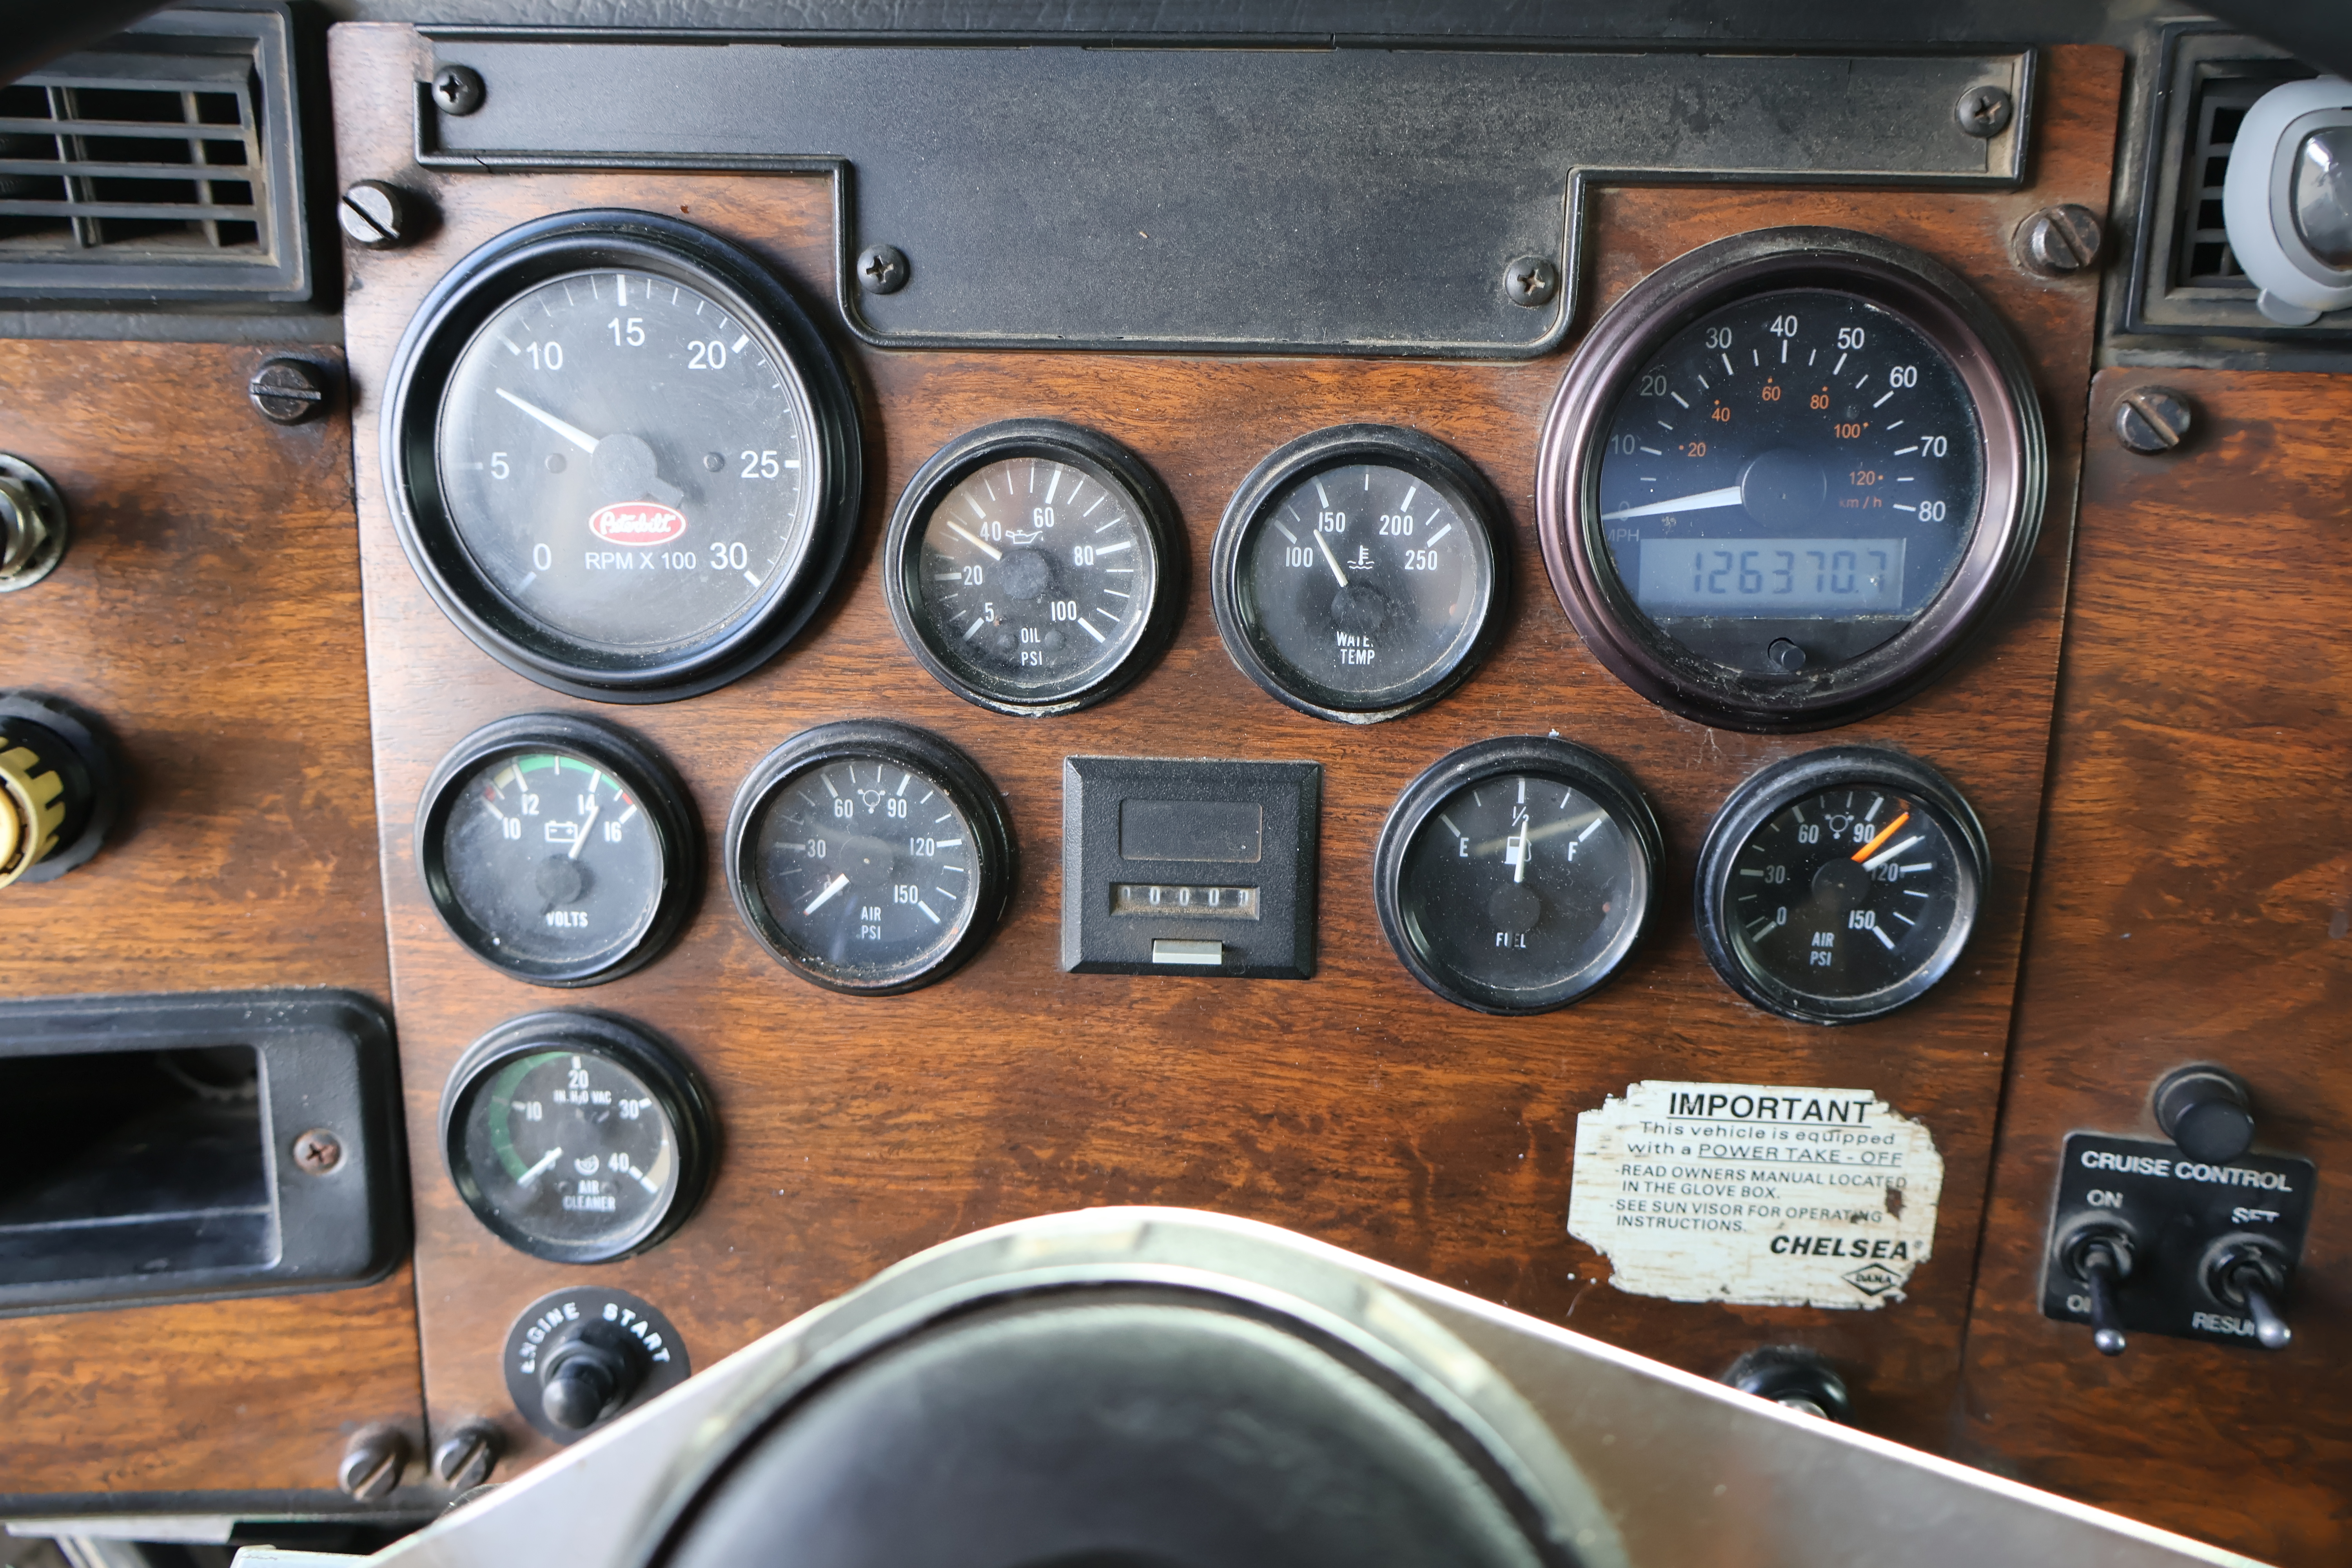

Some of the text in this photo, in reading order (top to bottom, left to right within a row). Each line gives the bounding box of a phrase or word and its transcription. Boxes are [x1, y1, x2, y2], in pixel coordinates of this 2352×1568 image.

[608, 318, 645, 346] 15
[1770, 316, 1797, 337] 40
[1706, 327, 1731, 349] 30
[1837, 327, 1864, 349] 50
[527, 343, 563, 370] 10
[688, 341, 727, 369] 20
[1641, 375, 1666, 396] 20
[1890, 366, 1917, 387] 60
[1762, 387, 1780, 401] 60
[1810, 394, 1829, 409] 80
[1712, 407, 1730, 422] 40
[1834, 424, 1860, 439] 100
[1611, 434, 1635, 455] 10
[1688, 442, 1706, 457] 20
[1920, 436, 1947, 457] 70
[491, 452, 509, 479] 5
[740, 451, 779, 478] 25
[1849, 471, 1876, 485] 120
[1034, 508, 1054, 528] 60
[1319, 512, 1345, 532] 150
[1918, 502, 1945, 522] 80
[980, 521, 1001, 541] 40
[1379, 515, 1412, 535] 200
[534, 543, 551, 570] 0
[584, 552, 697, 570] RPM X 100
[710, 542, 748, 570] 30
[1074, 546, 1093, 566] 80
[1286, 547, 1313, 567] 100
[1405, 550, 1437, 570] 250
[964, 566, 983, 585] 20
[1694, 551, 1886, 594] 126370.7
[985, 603, 994, 621] 5
[1051, 601, 1077, 621] 100
[1021, 628, 1040, 643] OIL
[1337, 631, 1373, 647] WATE
[1021, 651, 1042, 666] PSI
[1340, 649, 1375, 664] TEMP
[521, 794, 539, 815] 12
[577, 793, 595, 815] 14
[835, 799, 853, 818] 60
[887, 799, 907, 818] 90
[503, 818, 521, 839] 10
[604, 821, 622, 842] 16
[1798, 824, 1819, 844] 60
[1853, 823, 1875, 843] 90
[808, 839, 826, 858] 30
[910, 837, 935, 856] 120
[1459, 837, 1468, 857] E
[1568, 841, 1578, 861] F
[1765, 865, 1785, 884] 30
[894, 885, 918, 904] 150
[546, 912, 588, 927] VOLTS
[861, 906, 881, 920] AIR
[1776, 907, 1786, 925] 0
[1849, 910, 1876, 929] 150
[862, 925, 881, 939] PSI
[1811, 932, 1834, 947] AIR
[1810, 951, 1831, 966] PSI
[568, 1069, 588, 1089] 20
[591, 1090, 612, 1104] VAC
[526, 1102, 543, 1120] 10
[619, 1099, 639, 1120] 30
[1669, 1092, 1873, 1123] IMPORTANT
[1639, 1121, 1896, 1145] This vehicle is equipped
[608, 1152, 630, 1173] 40
[1628, 1142, 1674, 1154] with
[1681, 1145, 1691, 1155] a
[1699, 1143, 1779, 1160] POWER
[1785, 1147, 1841, 1163] TAKE
[1860, 1151, 1904, 1165] OFF
[1671, 1166, 1747, 1181] OWNERS
[1750, 1169, 1824, 1185] MANUAL
[1829, 1173, 1907, 1189] LOCATED
[2081, 1150, 2292, 1192] CRUISE CONTROL
[578, 1180, 599, 1194] AIR
[1622, 1180, 1780, 1199] IN THE GLOVE BOX.
[562, 1196, 616, 1212] CLEANER
[1652, 1201, 1686, 1214] SUN
[1692, 1202, 1743, 1216] VISOR
[1748, 1205, 1781, 1217] FOR
[2087, 1189, 2123, 1209] ON
[1617, 1215, 1747, 1232] INSTRUCTIONS.
[2231, 1207, 2280, 1223] SET
[1770, 1234, 1907, 1260] CHELSEA
[603, 1303, 671, 1363] START
[2192, 1311, 2254, 1337] RESU
